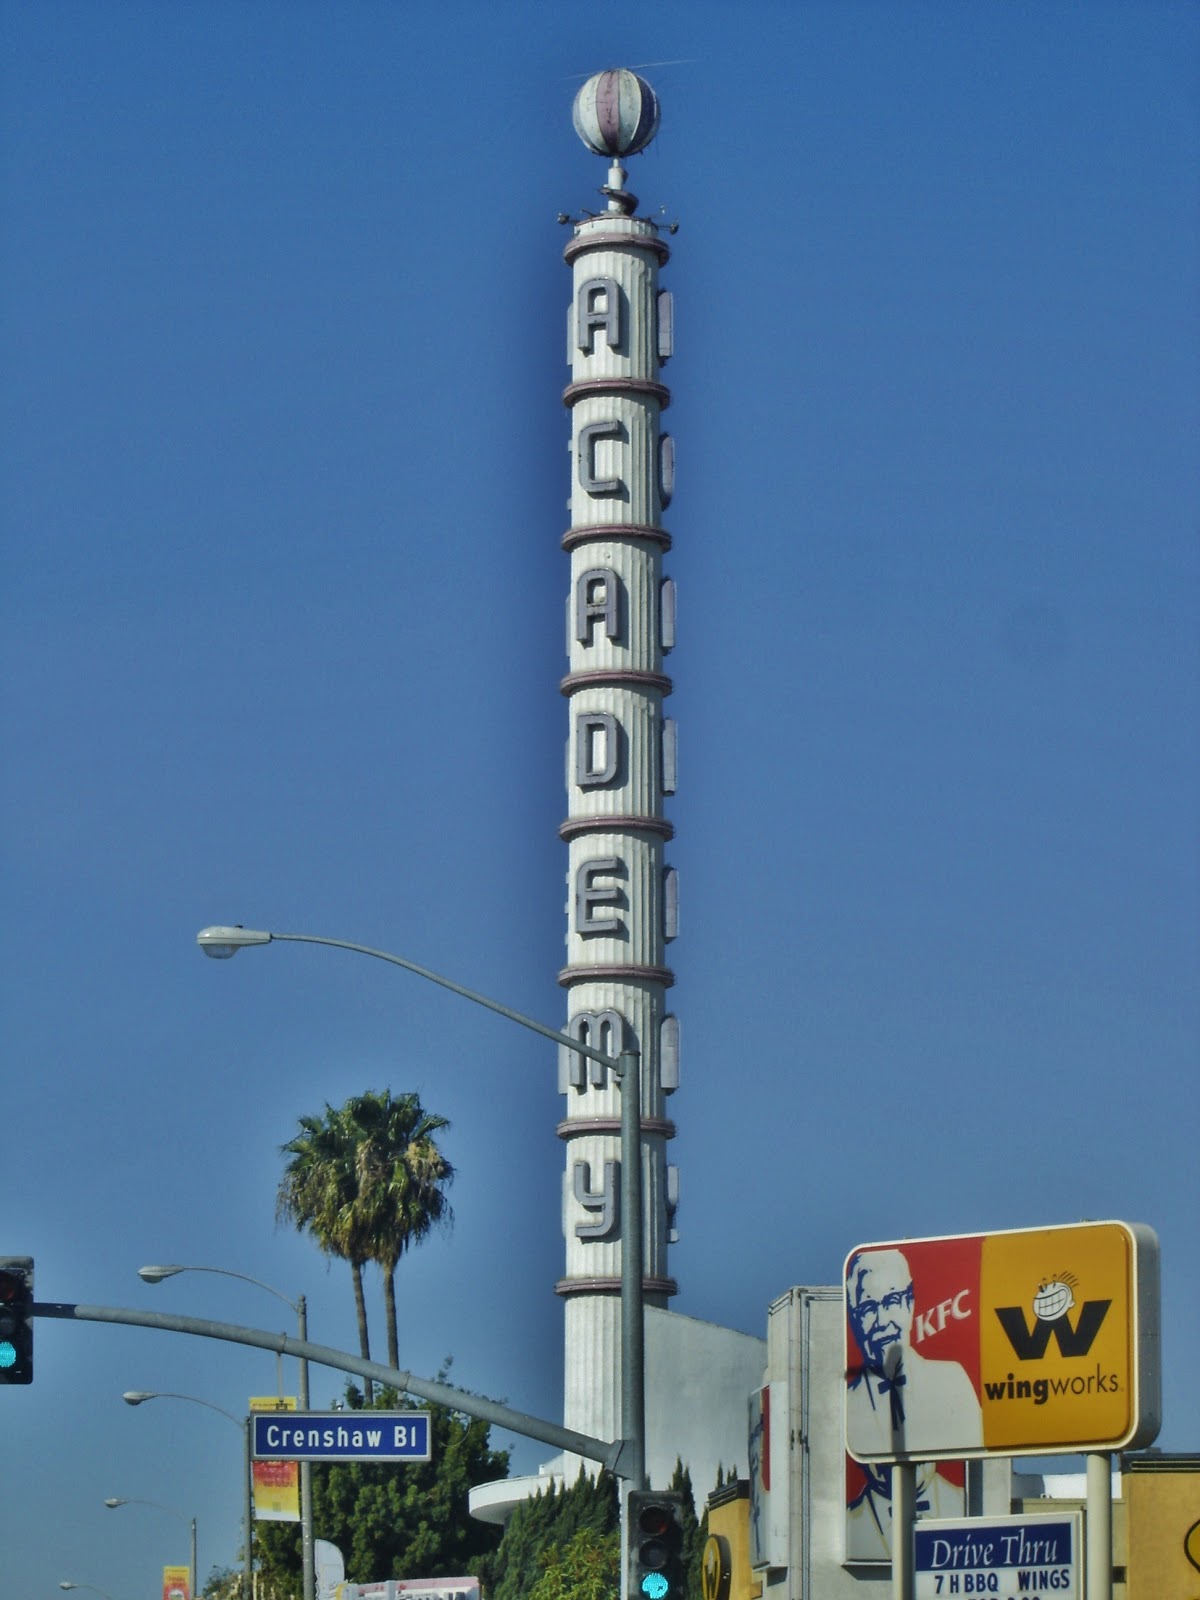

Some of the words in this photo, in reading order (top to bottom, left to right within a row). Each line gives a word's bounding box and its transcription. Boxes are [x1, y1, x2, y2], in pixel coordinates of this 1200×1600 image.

[914, 1288, 972, 1344] KFC
[266, 1425, 382, 1448] Crenshaw
[394, 1425, 416, 1448] Bl
[930, 1534, 994, 1569] Drive
[1000, 1528, 1058, 1565] Thru
[1017, 1569, 1070, 1592] WINGS
